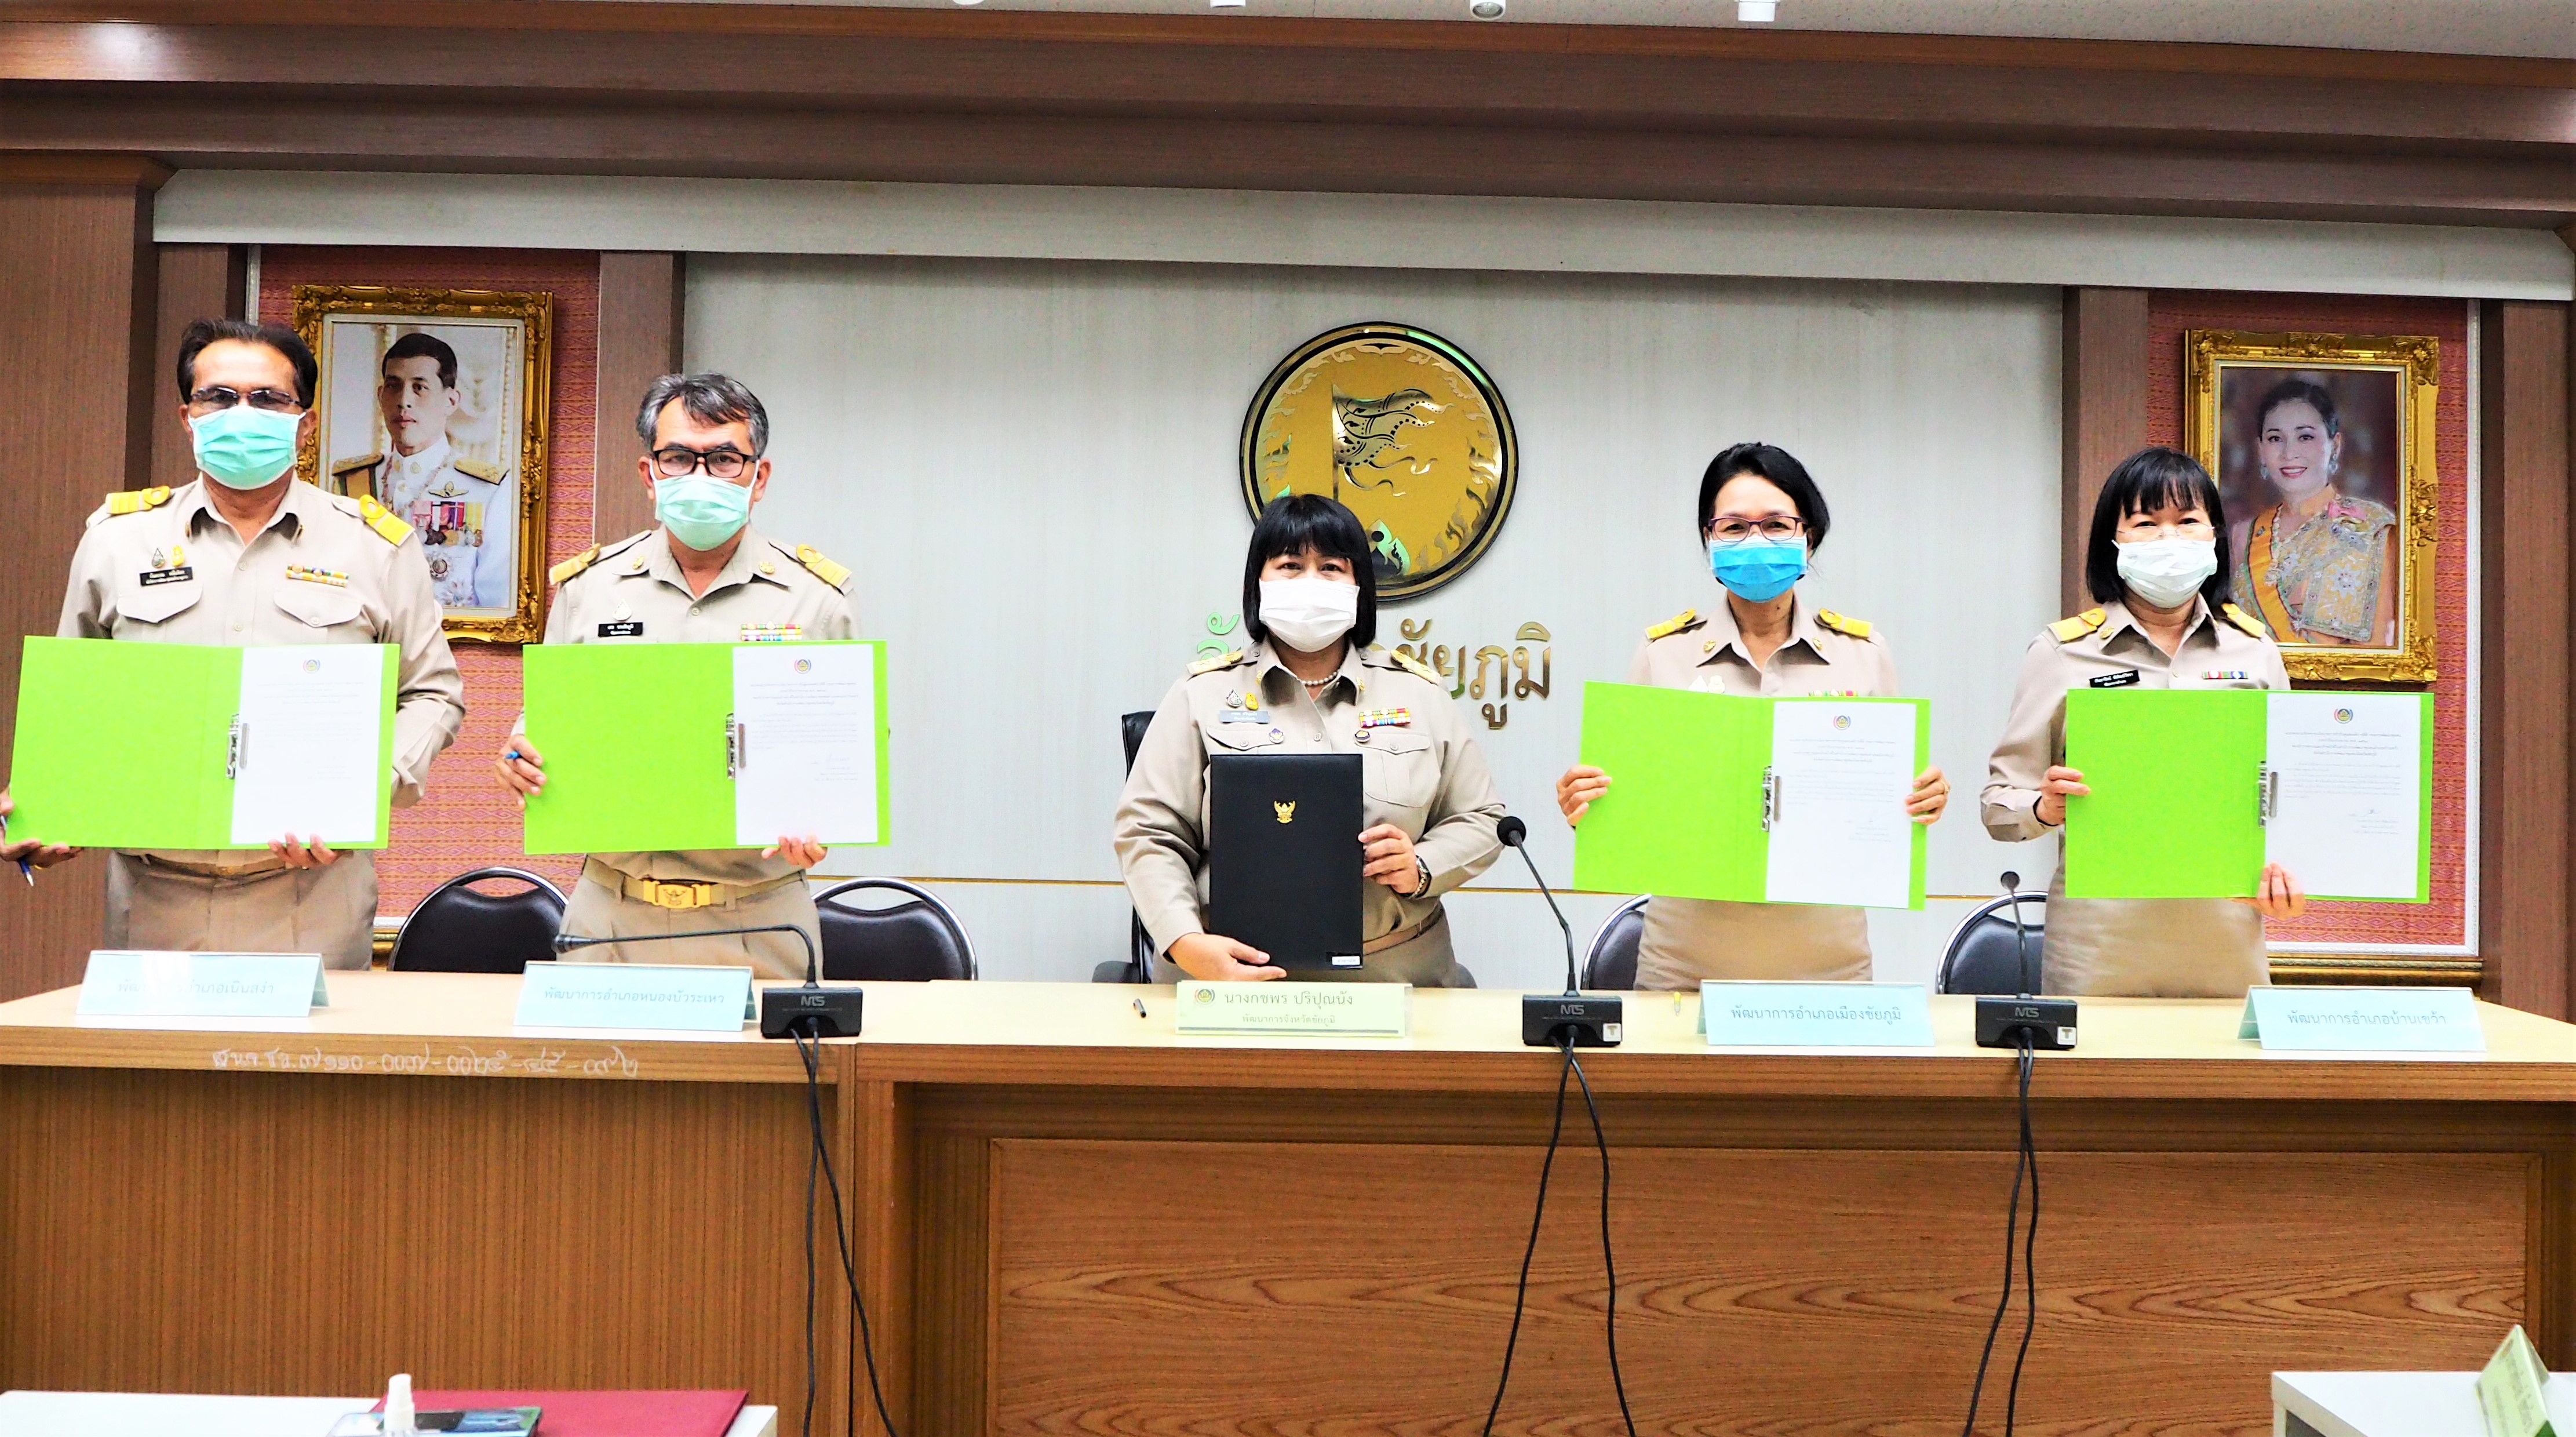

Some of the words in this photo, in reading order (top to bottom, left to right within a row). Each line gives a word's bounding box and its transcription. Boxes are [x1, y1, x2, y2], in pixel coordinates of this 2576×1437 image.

[1730, 1005, 1901, 1025] พัฒนาการอำเภอเมืองชัยภูมิ
